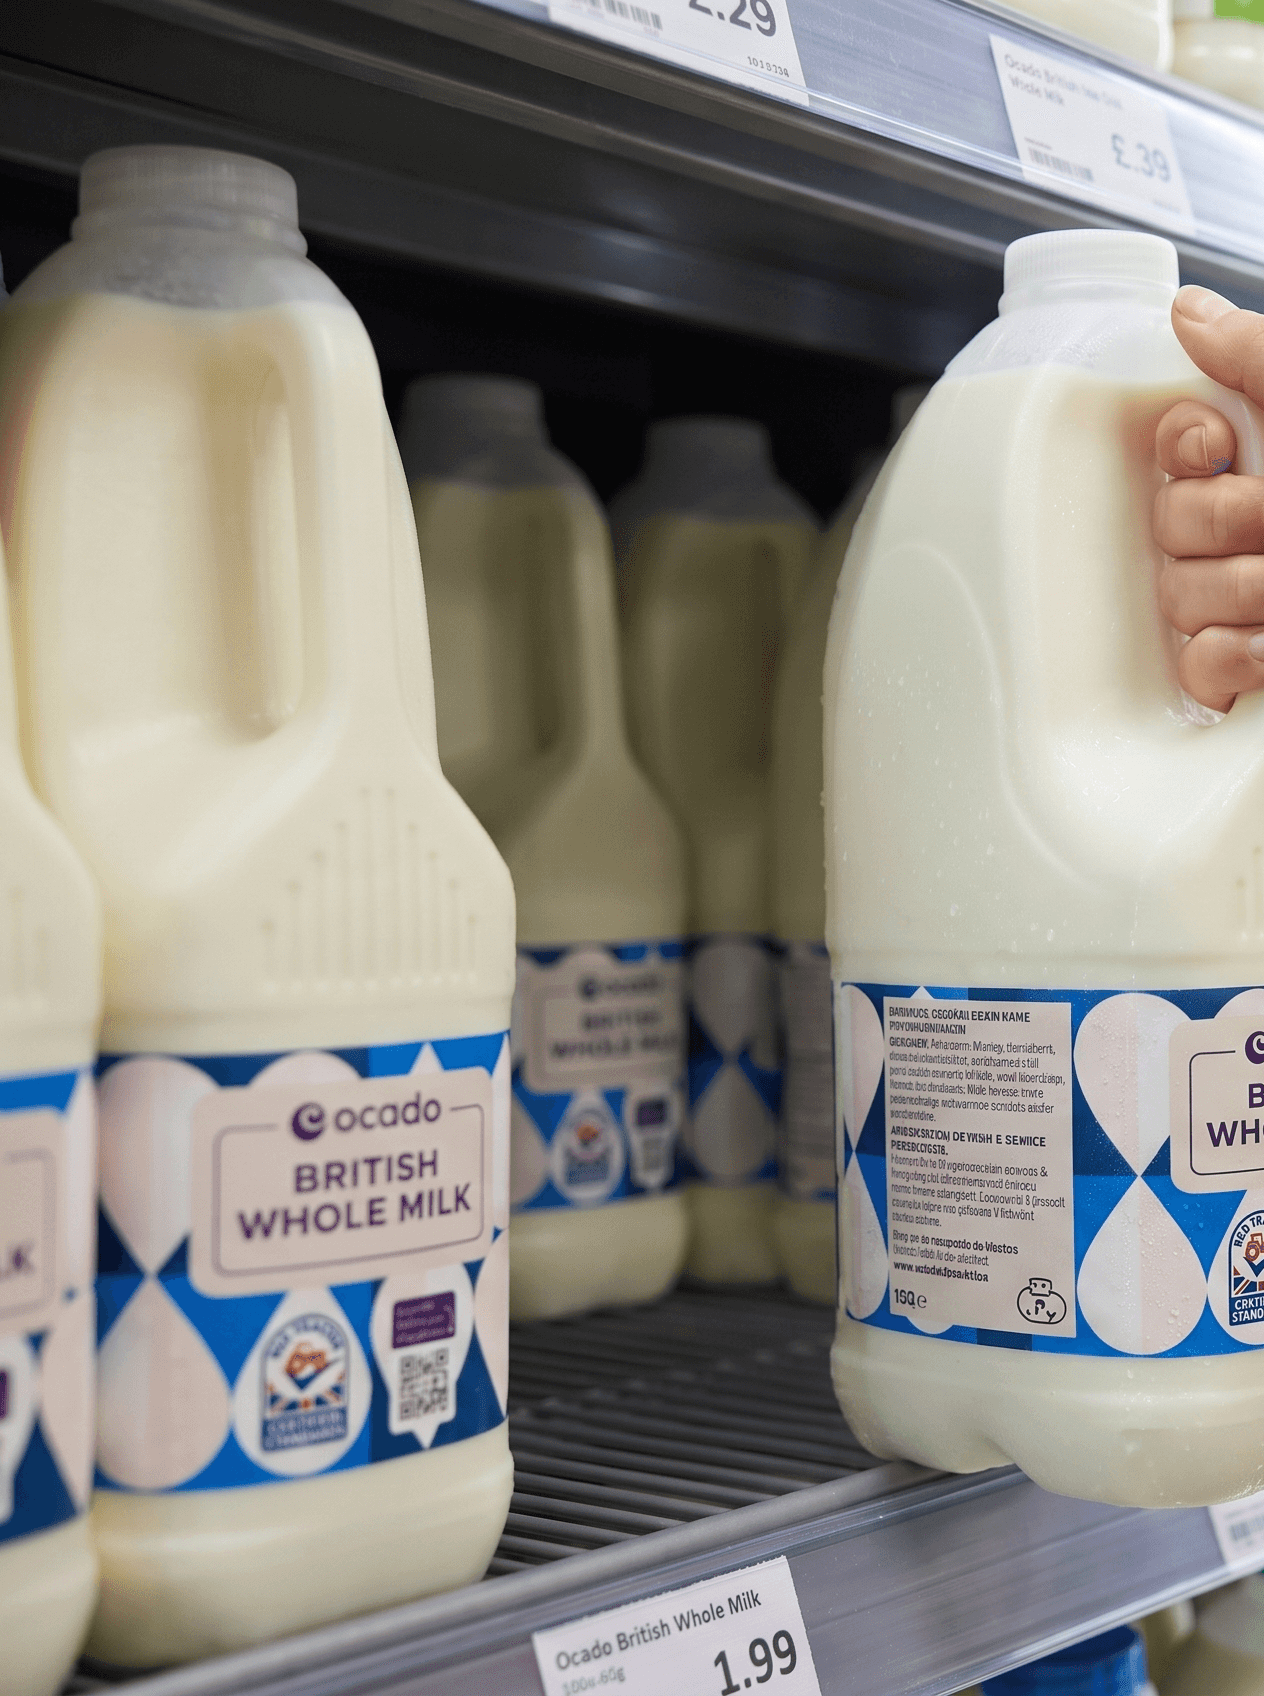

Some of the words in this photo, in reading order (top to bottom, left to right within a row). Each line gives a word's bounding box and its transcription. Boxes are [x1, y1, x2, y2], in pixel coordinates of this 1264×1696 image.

[334, 1091, 442, 1133] ocado
[294, 1149, 438, 1194] BRITISH
[237, 1196, 388, 1241] WHOLE
[399, 1182, 471, 1224] MILK
[555, 1639, 613, 1671] Ocado
[616, 1618, 671, 1652] British
[673, 1602, 726, 1633] Whole
[727, 1589, 762, 1615] Milk
[713, 1629, 798, 1696] 1.99
